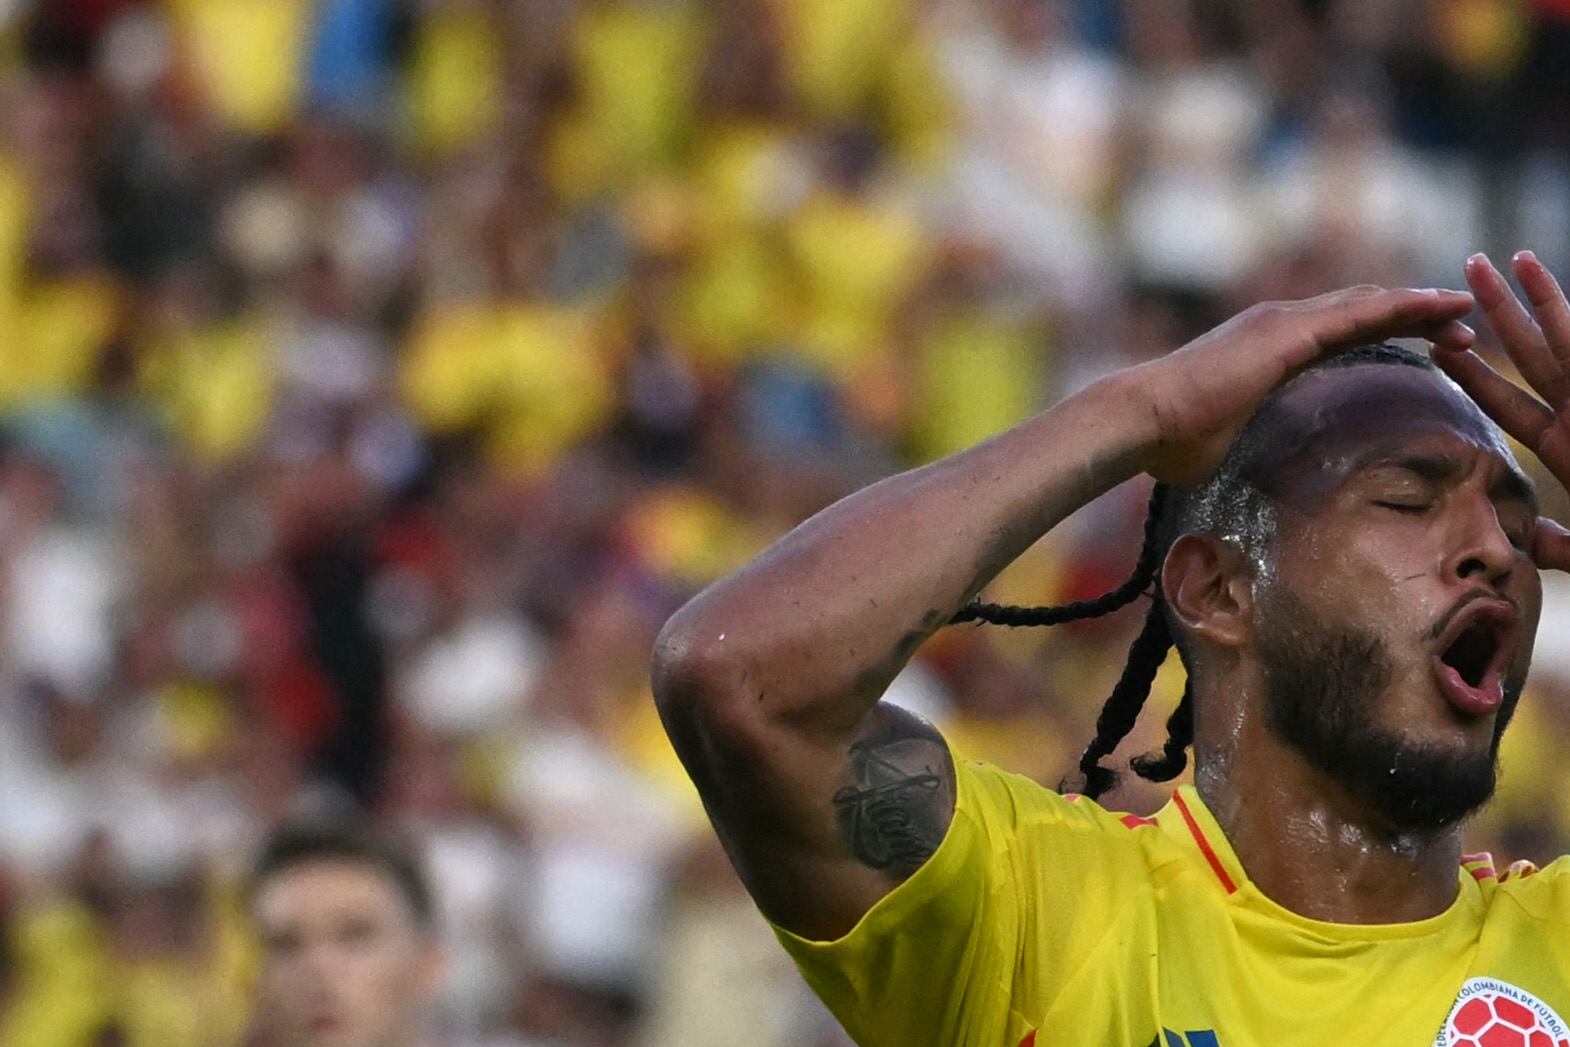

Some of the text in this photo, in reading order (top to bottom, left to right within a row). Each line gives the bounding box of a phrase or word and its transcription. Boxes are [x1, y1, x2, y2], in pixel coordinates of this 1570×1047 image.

[1457, 982, 1518, 999] COLOMBIANA
[1521, 994, 1533, 1006] DE
[1534, 1003, 1564, 1038] FUTBOL
